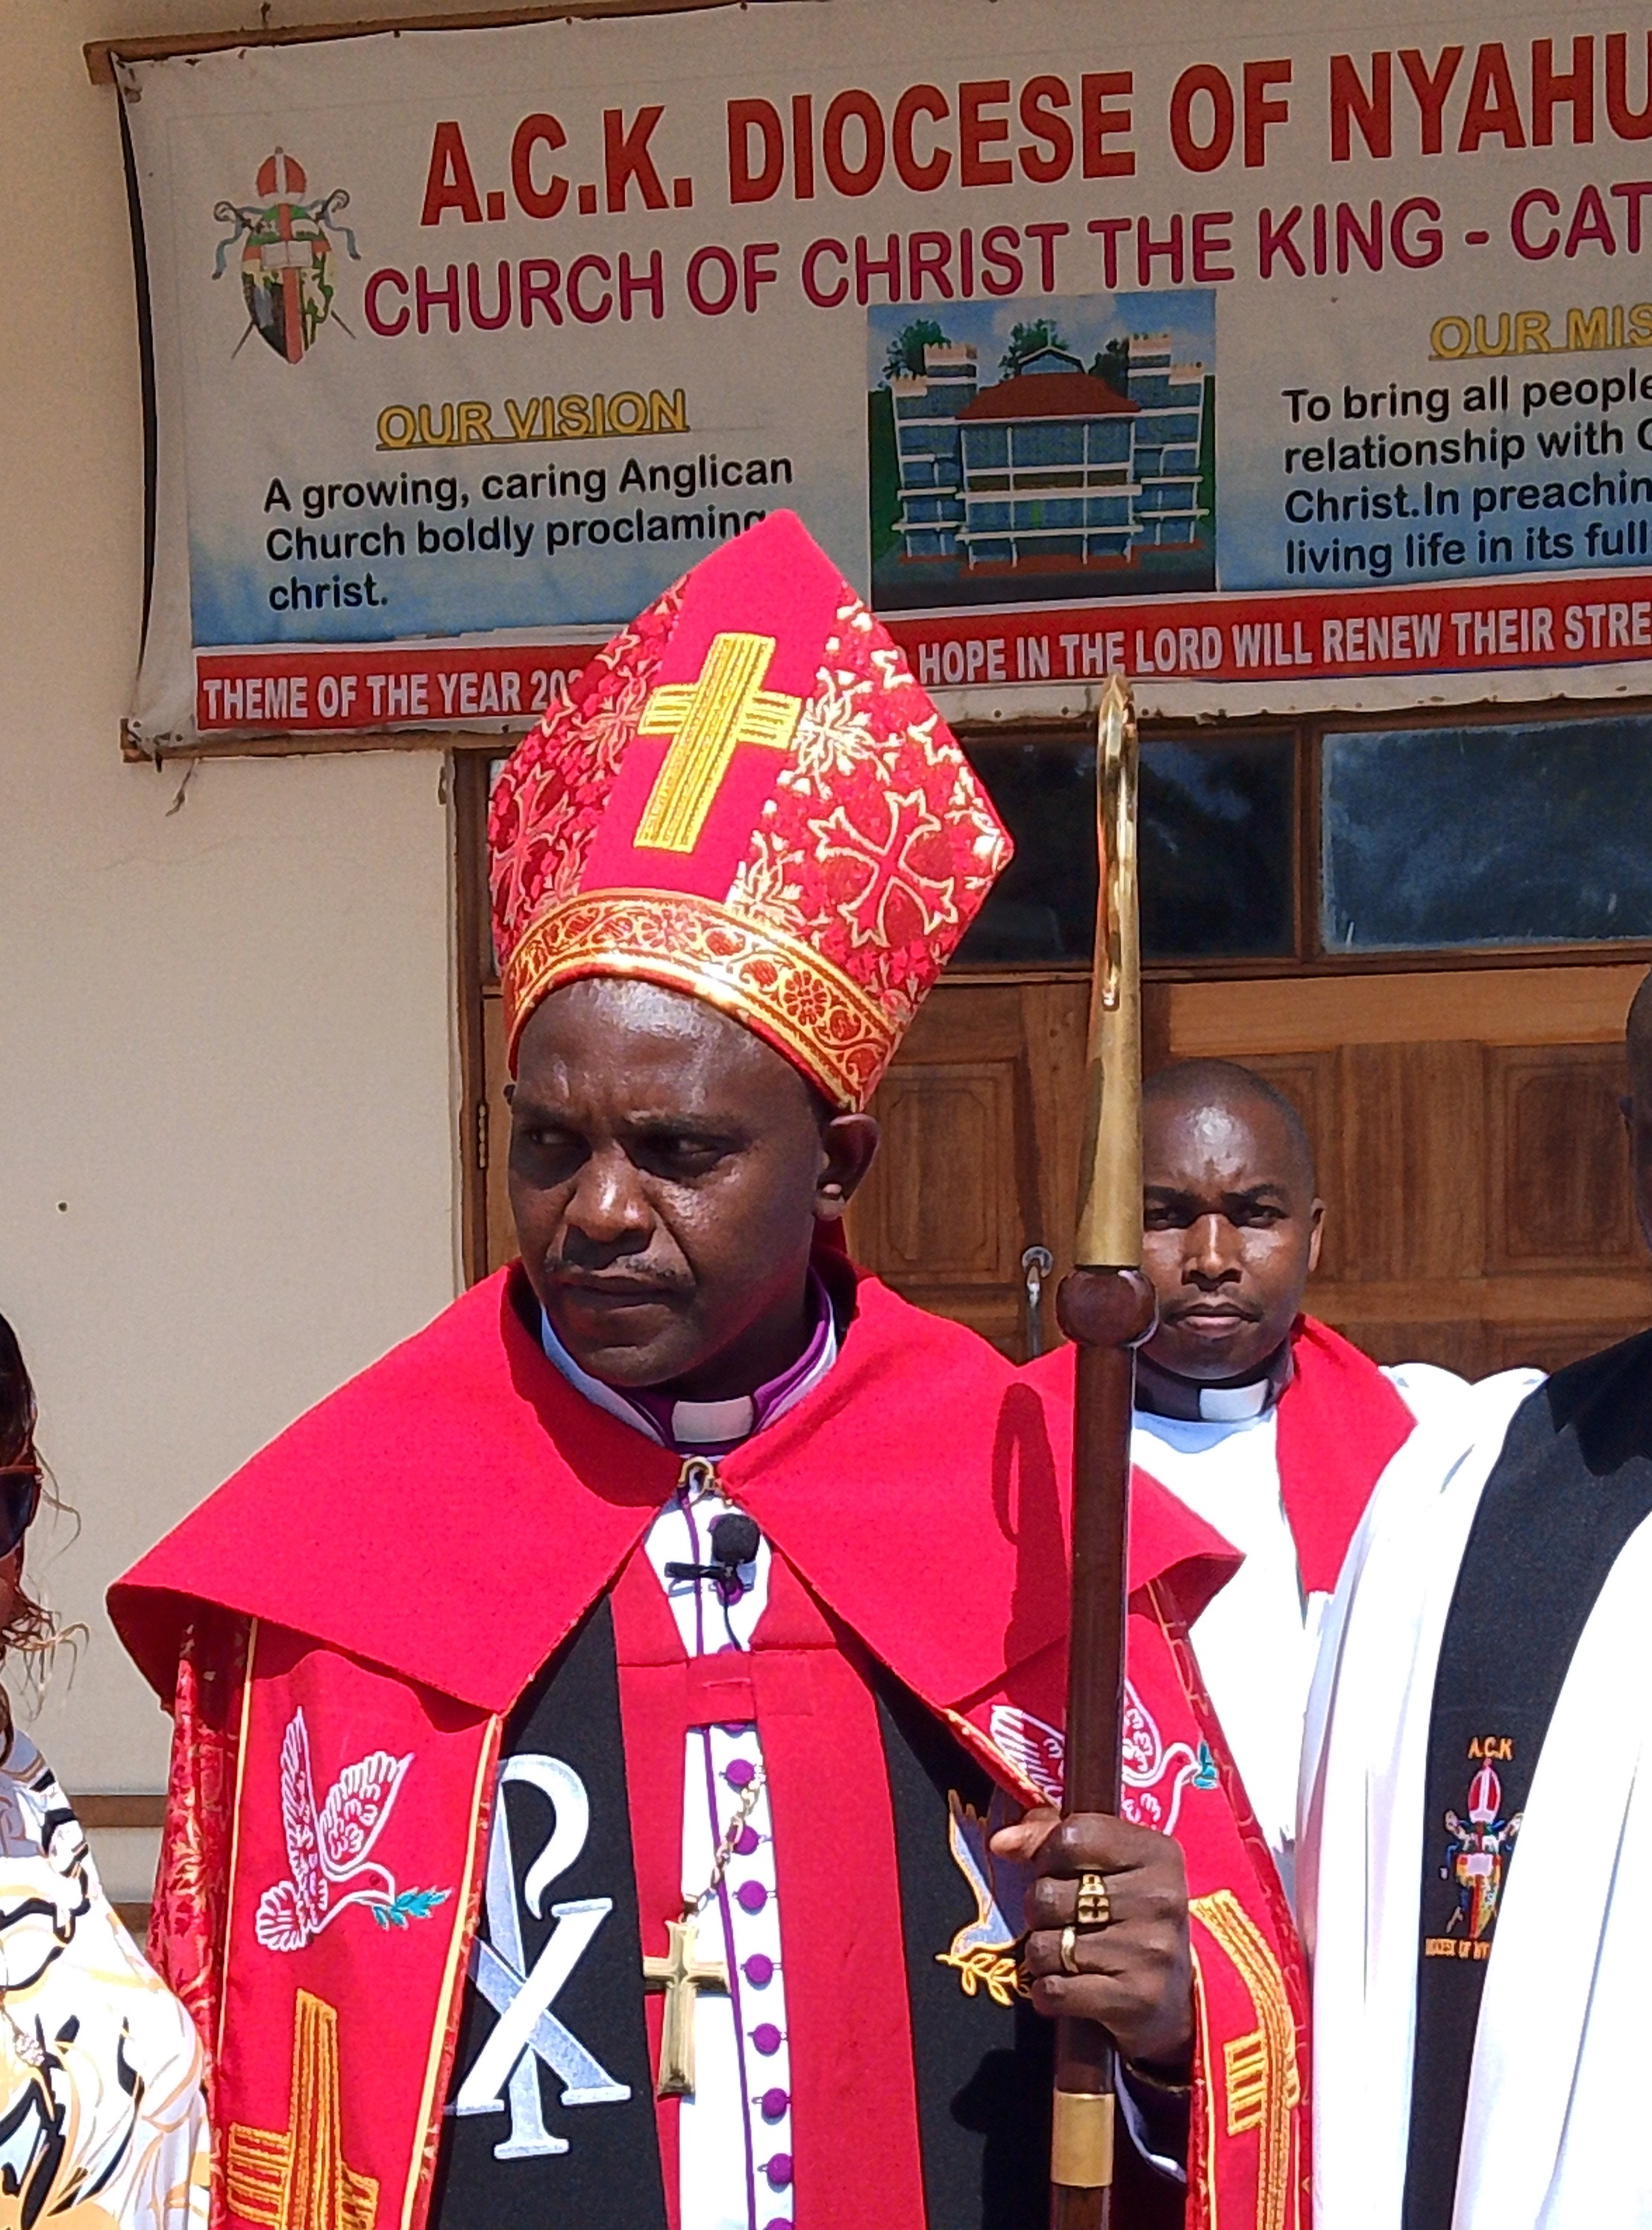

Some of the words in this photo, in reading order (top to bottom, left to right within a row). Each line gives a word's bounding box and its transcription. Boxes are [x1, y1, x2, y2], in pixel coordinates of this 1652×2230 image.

[422, 106, 693, 226] A.C.K.
[728, 72, 1136, 204] DIOCESE
[1170, 60, 1292, 172] OF
[365, 254, 663, 336] CHURCH
[687, 243, 777, 315] OF
[801, 224, 1069, 307] CHRIST
[1089, 213, 1234, 287] THE
[1260, 198, 1443, 277] KING
[1512, 182, 1652, 259] CAT
[1430, 310, 1551, 359] OUR
[377, 401, 491, 449] OUR
[506, 391, 686, 442] VISION
[1281, 389, 1331, 424] To
[1344, 379, 1449, 424] bring
[1463, 374, 1508, 412] all
[1284, 428, 1525, 474] relationship
[1536, 420, 1623, 459] with
[263, 477, 292, 515] A
[302, 471, 471, 518] growing,
[482, 464, 606, 503] caring
[619, 454, 793, 498] Anglican
[266, 522, 405, 562] Church
[418, 515, 535, 557] boldly
[1286, 537, 1393, 579] living
[1406, 532, 1466, 568] life
[1478, 529, 1513, 564] in
[1527, 527, 1574, 561] its
[1584, 518, 1652, 558] full
[269, 573, 388, 611] christ.
[918, 638, 1007, 685] HOPE
[1017, 635, 1050, 679] IN
[1059, 631, 1125, 676] THE
[1136, 626, 1222, 673] LORD
[1231, 621, 1313, 668] WILL
[1322, 613, 1442, 663] RENEW
[1451, 608, 1554, 656] THEIR
[1565, 601, 1652, 650] STRE
[203, 676, 308, 720] THEME
[317, 676, 357, 717] OF
[366, 673, 429, 716] THE
[439, 670, 522, 714] YEAR
